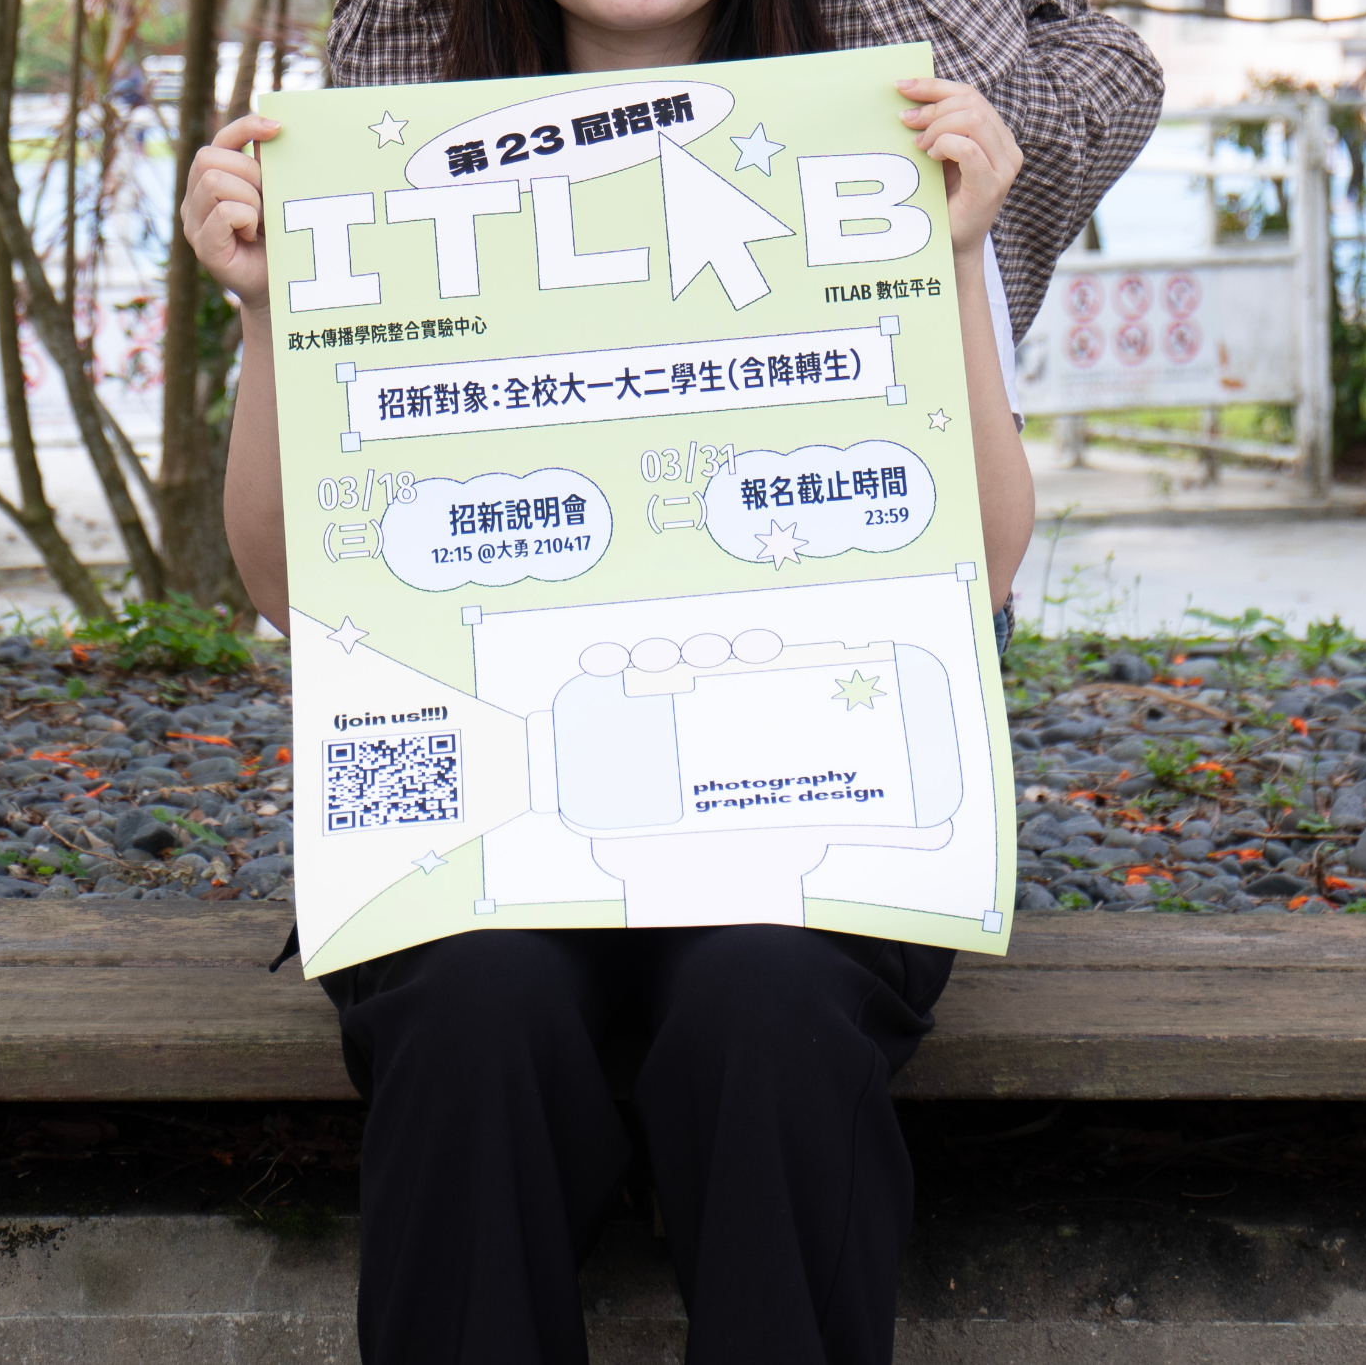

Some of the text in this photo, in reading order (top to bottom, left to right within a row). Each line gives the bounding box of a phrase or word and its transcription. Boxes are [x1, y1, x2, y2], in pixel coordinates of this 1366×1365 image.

[825, 277, 942, 304] ITLAB 數位平台
[288, 315, 488, 351] 政大傳播學院整合實驗中心
[640, 441, 737, 484] 03/31
[318, 469, 418, 512] 03/18
[740, 466, 909, 511] 報名截止時間
[449, 493, 588, 537] 招新說明會
[647, 491, 708, 534] (二)
[864, 506, 910, 526] 23:59
[323, 519, 385, 564] (三)
[431, 546, 473, 564] 12:15
[534, 535, 592, 555] 210417
[333, 705, 449, 732] (join us!!!)
[693, 770, 858, 796] photography
[695, 785, 885, 813] graphic design
